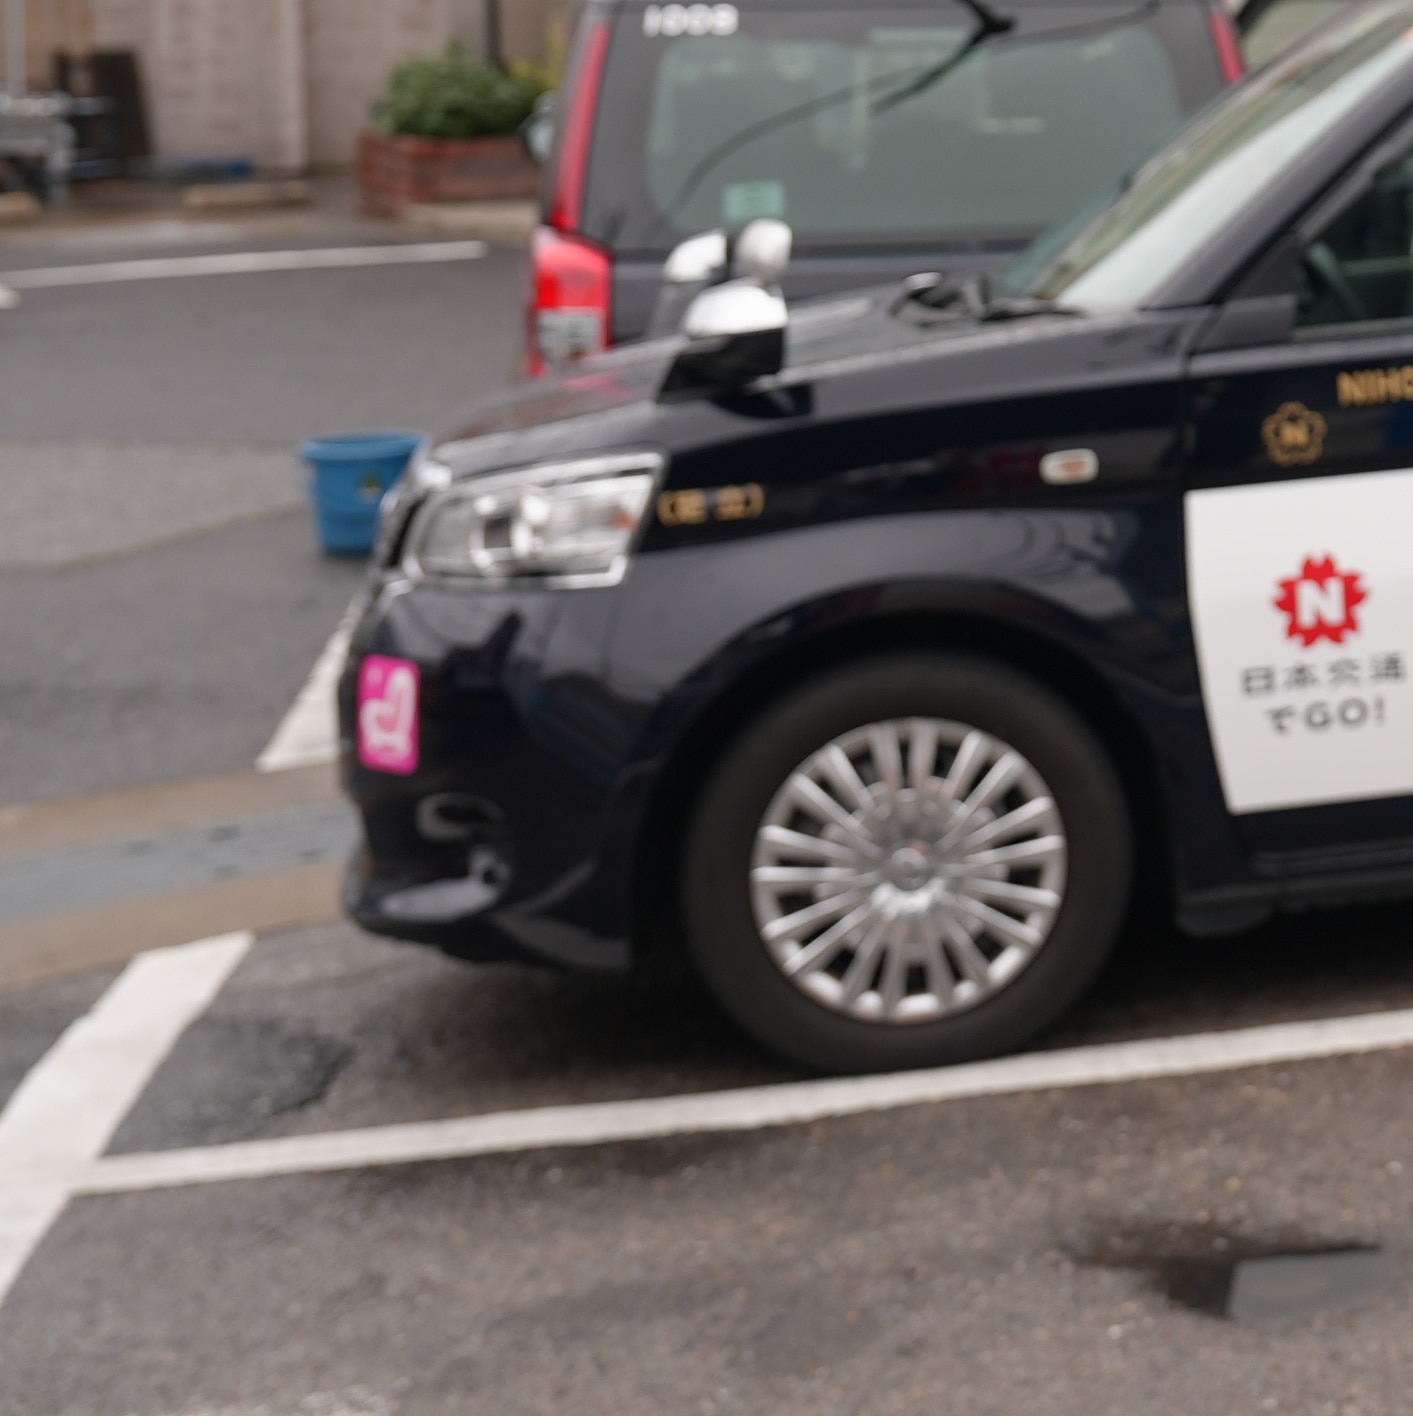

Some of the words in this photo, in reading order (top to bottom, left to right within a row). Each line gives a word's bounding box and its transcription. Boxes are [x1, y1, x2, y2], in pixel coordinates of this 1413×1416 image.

[1294, 577, 1347, 630] N
[1240, 650, 1407, 697] 日本交通
